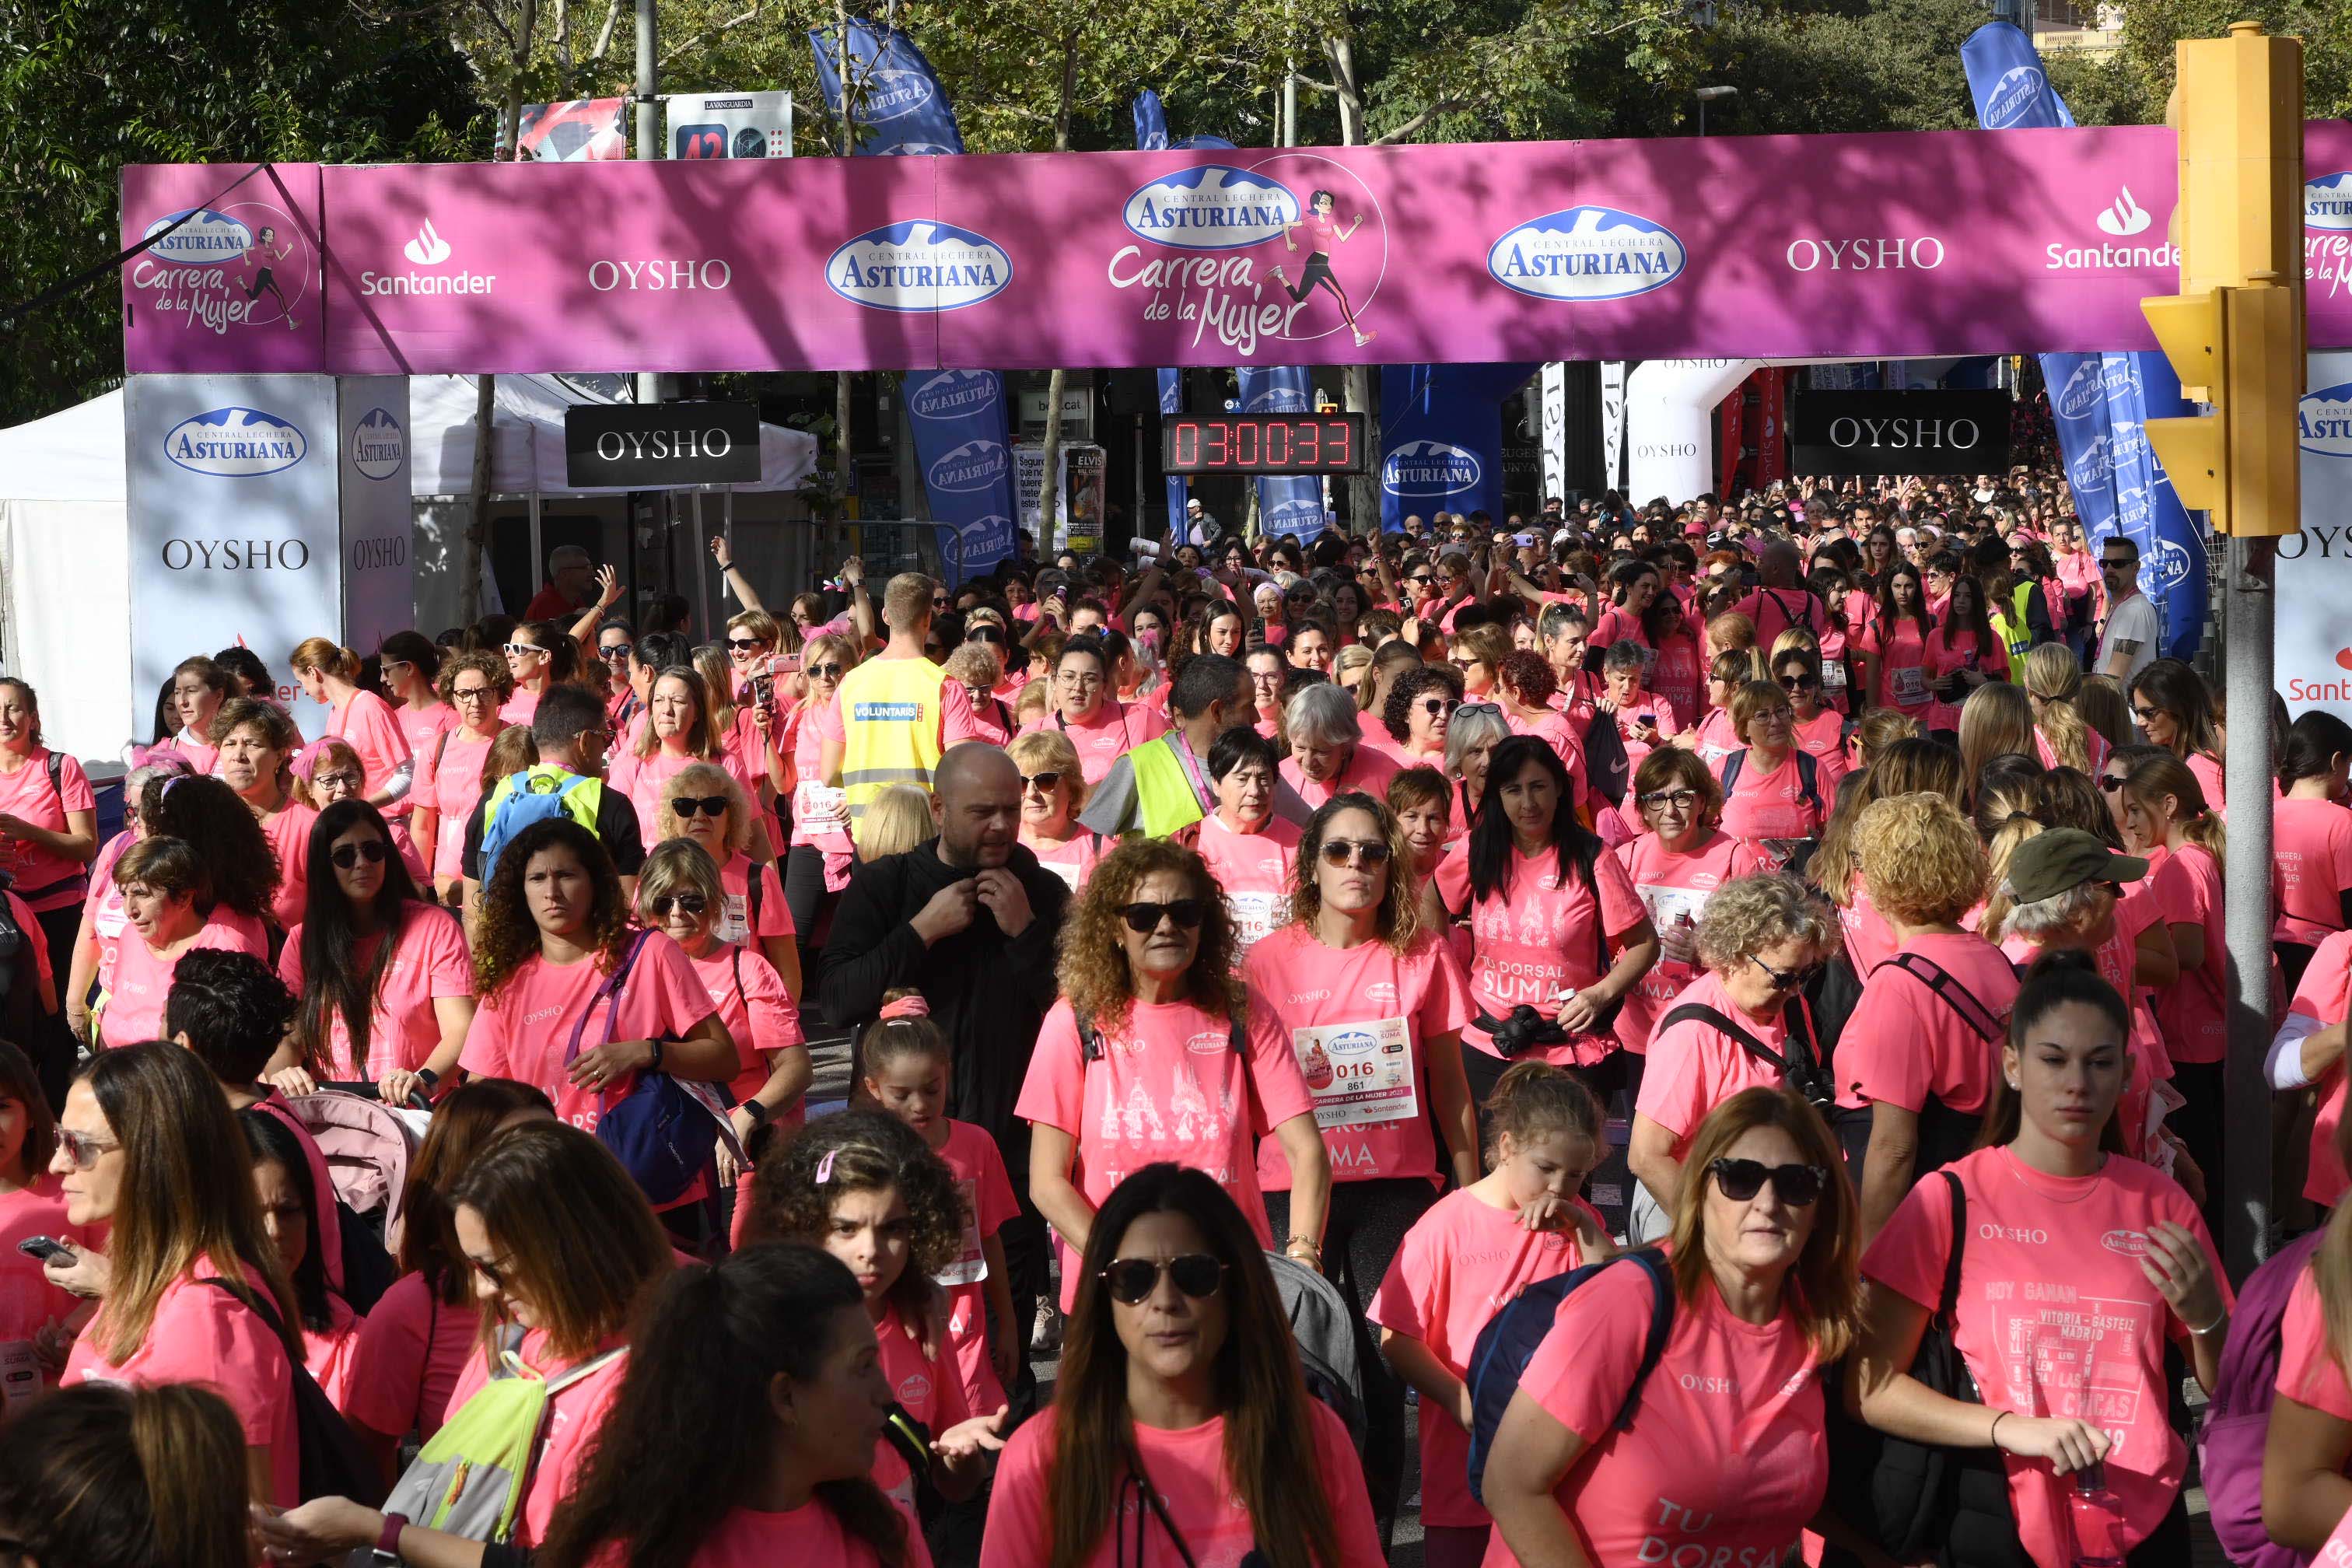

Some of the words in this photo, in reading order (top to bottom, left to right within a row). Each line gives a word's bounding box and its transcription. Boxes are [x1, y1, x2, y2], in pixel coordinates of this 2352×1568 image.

[1164, 193, 1220, 203] CENTRAL
[1225, 192, 1281, 202] LECHERA
[1136, 196, 1285, 229] ASTURIANA
[1534, 239, 1595, 250] CENTRAL
[1599, 236, 1664, 248] LECHERA
[1787, 236, 1945, 271] OYSHO
[869, 251, 928, 261] CENTRAL
[1108, 245, 1254, 289] Carrera
[1503, 242, 1671, 278] ASTURIANA
[134, 260, 225, 289] Carrera
[589, 259, 731, 291] OYSHO
[841, 254, 998, 288] ASTURIANA
[2319, 257, 2333, 280] la
[361, 270, 495, 296] Santander
[156, 291, 173, 310] de
[177, 291, 188, 310] la
[187, 287, 259, 334] Mujer
[1144, 293, 1171, 321] de
[1178, 294, 1195, 320] la
[1192, 282, 1308, 356] Mujer
[247, 430, 292, 439] LECHERA
[597, 428, 731, 461] OYSHO
[1176, 422, 1350, 465] 03:00:33
[1830, 418, 1979, 449] OYSHO
[176, 432, 296, 460] ASTURIANA
[355, 435, 401, 462] ASTURIANA
[1637, 443, 1698, 460] OYSHO
[1078, 456, 1102, 467] ELVIS
[1020, 470, 1032, 480] que
[1384, 463, 1473, 485] ASTURIANA
[162, 539, 309, 571] OYSHO
[354, 536, 405, 571] OYSHO
[1480, 955, 1496, 968] TU
[1500, 961, 1565, 978] DORSAL
[1483, 971, 1560, 1003] SUMA
[523, 1005, 563, 1025] OYSHO
[1332, 1040, 1373, 1052] ASTURIANA
[1336, 1062, 1374, 1079] 016
[1347, 1081, 1364, 1091] 861
[1314, 1096, 1345, 1104] CARRERA
[1374, 1104, 1408, 1113] Santander
[1979, 1223, 2049, 1244] OYSHO
[1458, 1250, 1511, 1266] OYSHO
[2041, 1310, 2081, 1327] VITORIA
[2092, 1315, 2135, 1332] GASTEIZ
[2061, 1325, 2104, 1342] MADRID
[2058, 1373, 2081, 1388] LAS
[1657, 1497, 1713, 1533] TU
